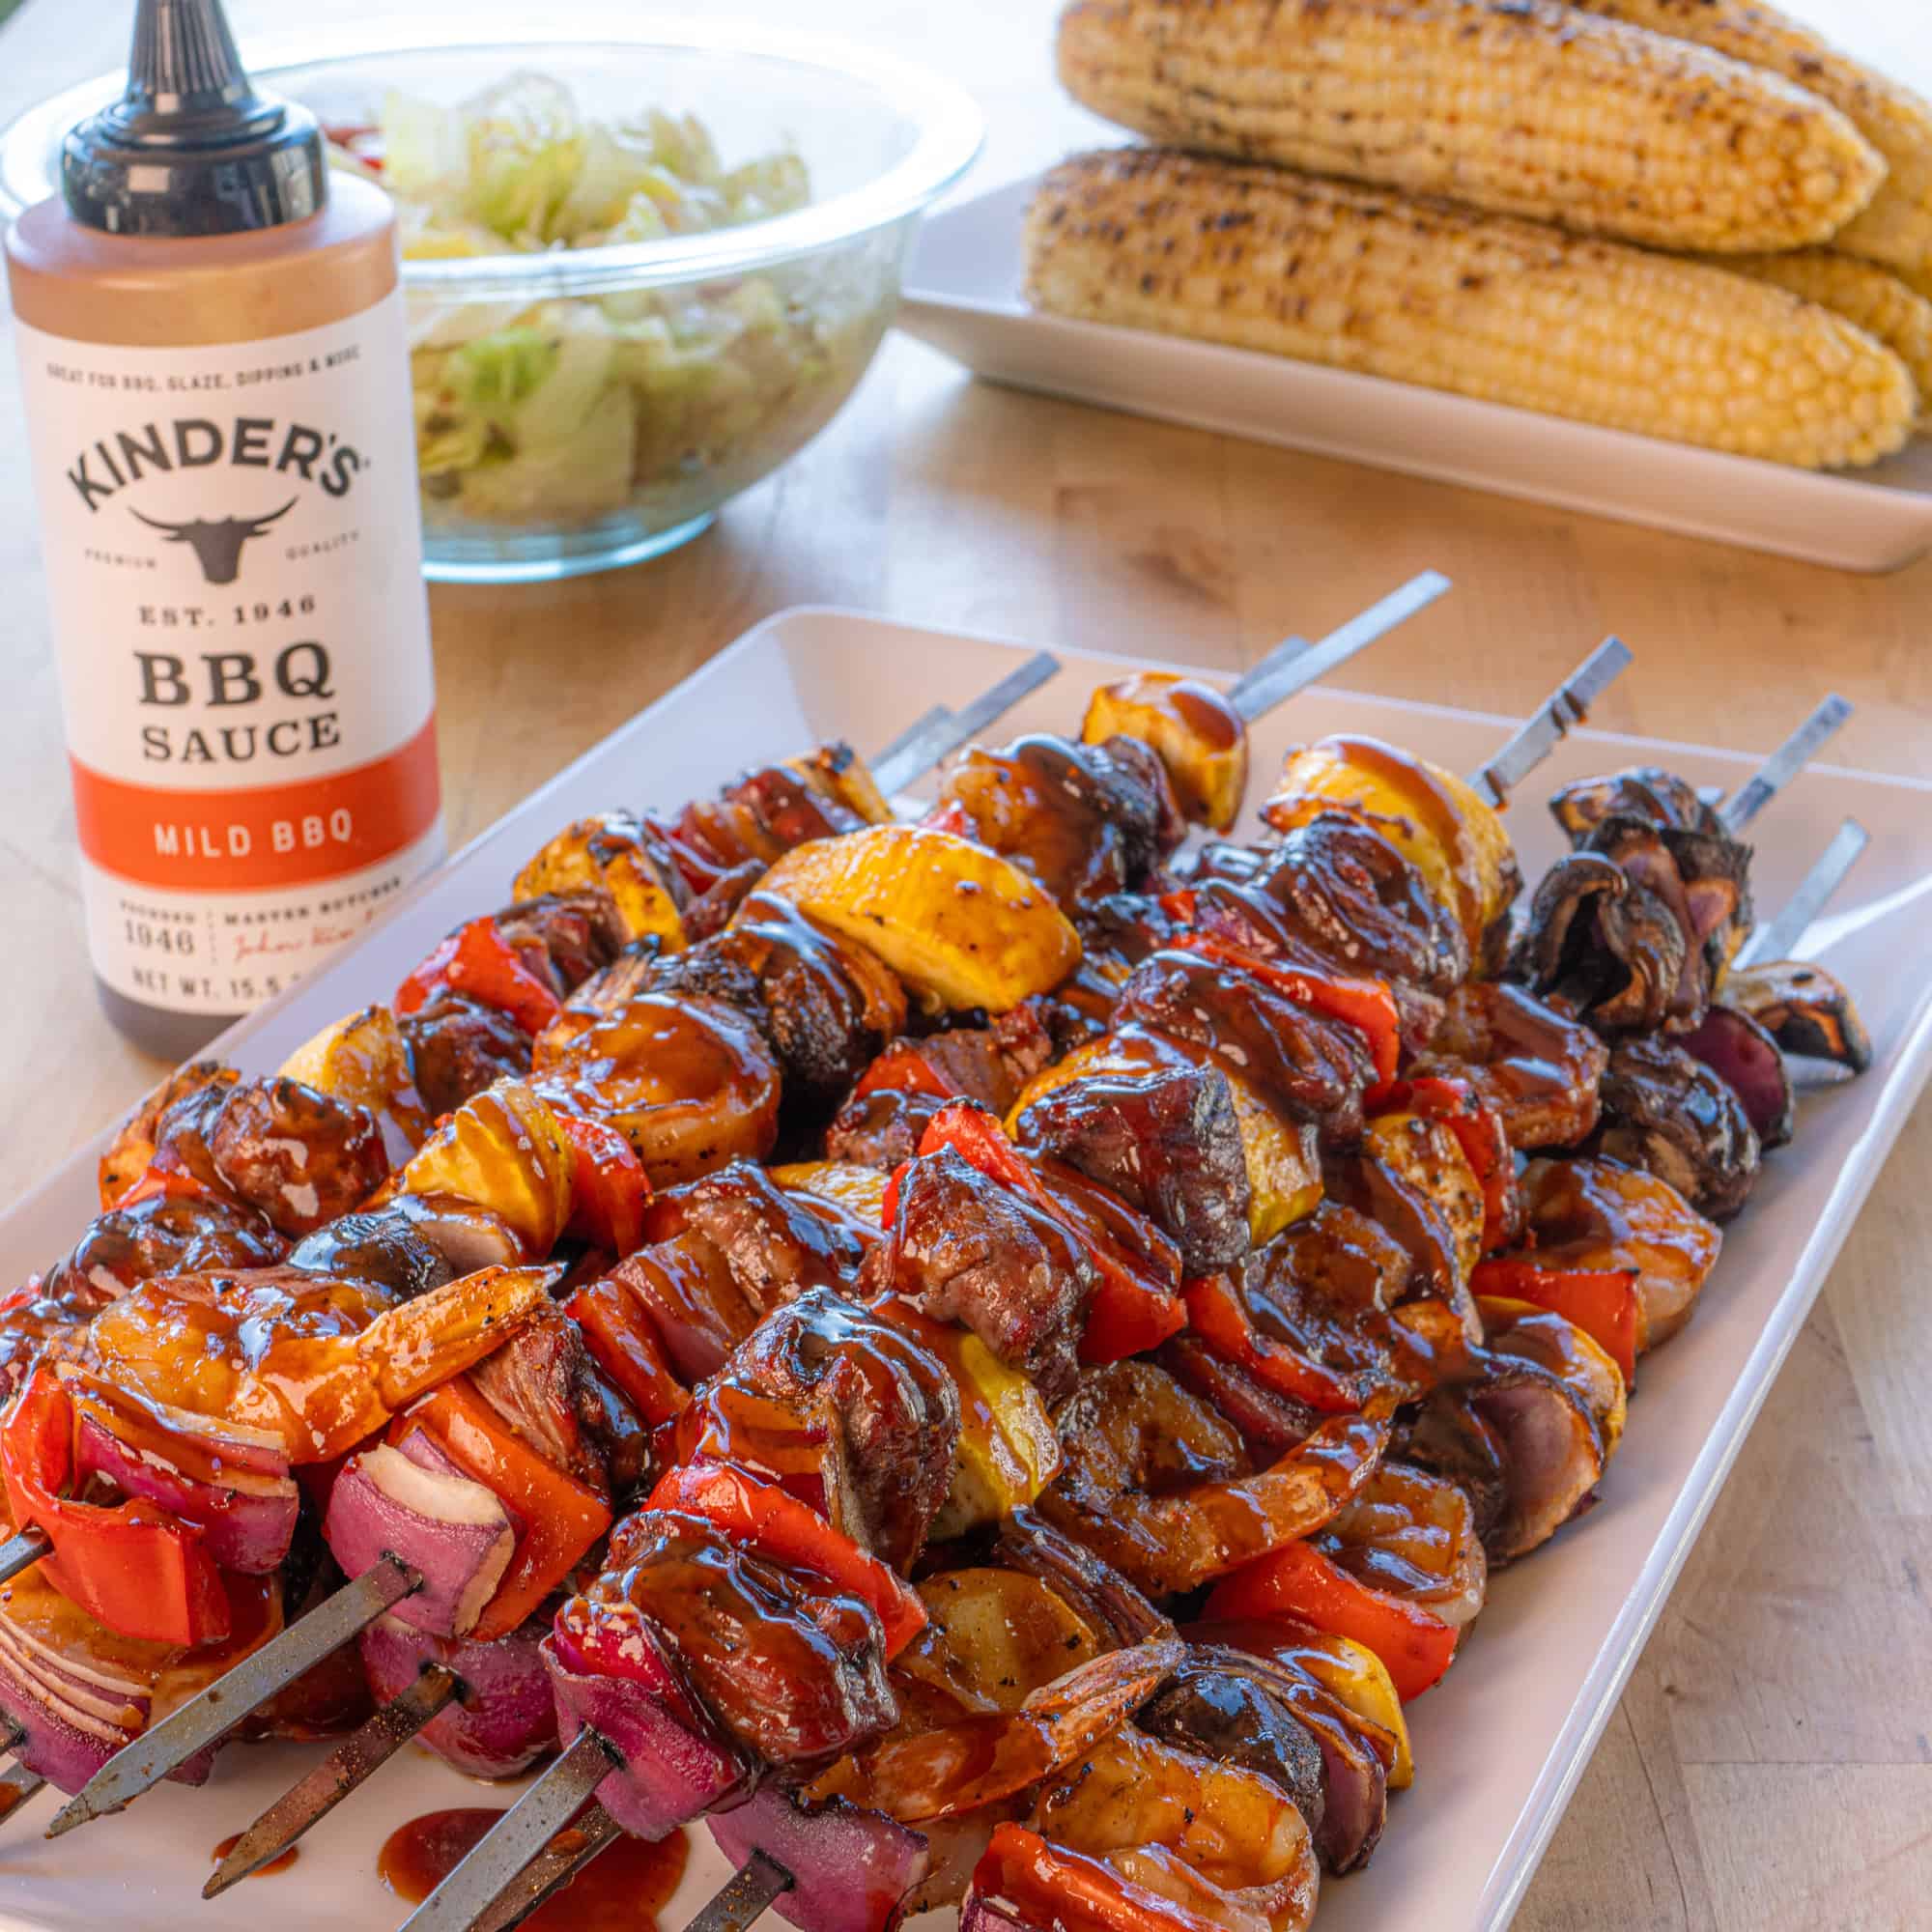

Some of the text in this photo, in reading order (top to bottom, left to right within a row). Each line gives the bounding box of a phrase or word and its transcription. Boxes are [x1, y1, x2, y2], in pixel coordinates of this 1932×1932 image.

[66, 416, 361, 513] KINDER'S
[138, 594, 317, 628] EST. 1946
[133, 639, 336, 707] BBQ
[141, 711, 341, 763] SAUCE
[154, 808, 354, 858] MILD BBQ
[125, 919, 194, 955] 1946
